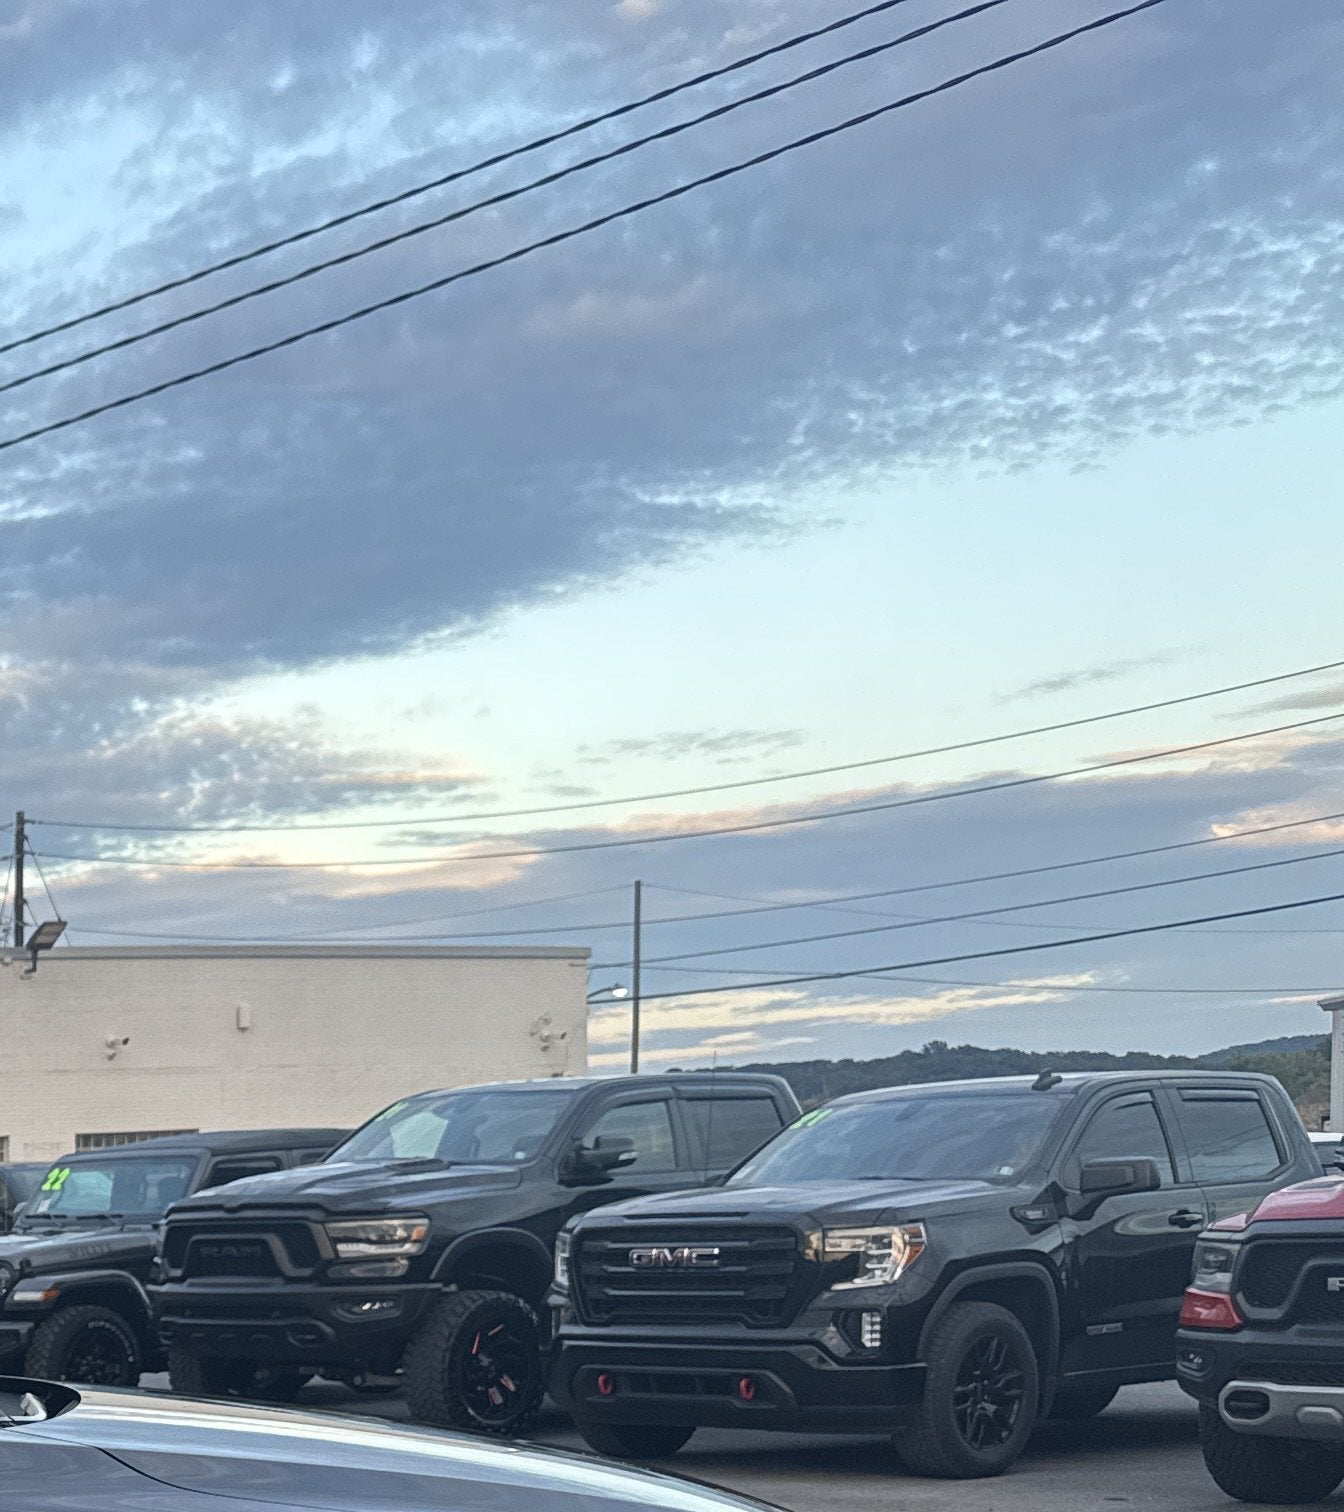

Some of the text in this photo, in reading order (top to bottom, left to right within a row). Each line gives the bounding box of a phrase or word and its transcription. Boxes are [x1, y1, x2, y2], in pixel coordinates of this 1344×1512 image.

[41, 1168, 70, 1191] 22
[199, 1246, 262, 1258] RAM
[628, 1247, 720, 1267] GMC
